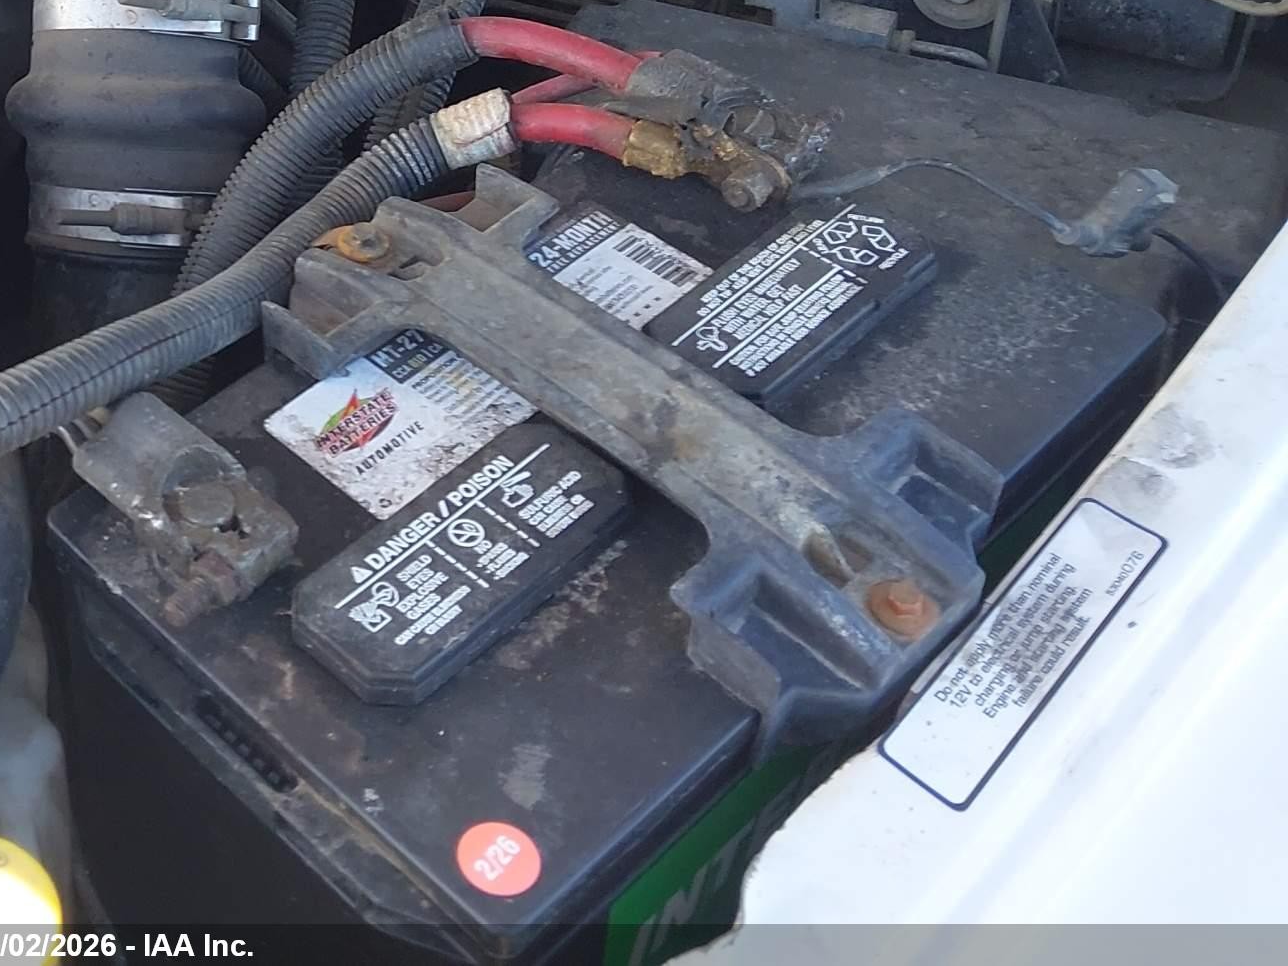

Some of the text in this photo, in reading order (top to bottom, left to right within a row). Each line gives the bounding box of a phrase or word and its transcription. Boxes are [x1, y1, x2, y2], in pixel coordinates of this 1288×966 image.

[530, 212, 612, 267] 24-MONTH
[567, 222, 619, 258] REPLACEMENT
[711, 258, 800, 328] FLUSH EYES IMMEDIATELY
[722, 317, 746, 333] WITH
[766, 284, 786, 297] GET
[732, 284, 804, 340] MEDICAL HELP FAST
[315, 393, 393, 448] INTERSTATE
[328, 405, 397, 456] BATTERIES
[355, 421, 425, 475] AUTOMOTIVE
[364, 512, 440, 569] DANGER
[446, 456, 514, 506] POISON
[518, 472, 581, 519] SULFURIC ACID
[397, 555, 432, 581] SHIELD
[474, 540, 492, 554] NO
[396, 572, 448, 612] EXPLOSIVE
[406, 569, 434, 589] EYES
[406, 593, 440, 619] GASES
[934, 553, 1061, 702] Do not apply more than nominal
[950, 564, 1075, 707] 12V to electrical system during
[975, 586, 1077, 706] charging or jump starting.
[982, 589, 1092, 718] Engine and starting system
[1012, 617, 1090, 707] failure could result.
[472, 835, 521, 882] 2/26
